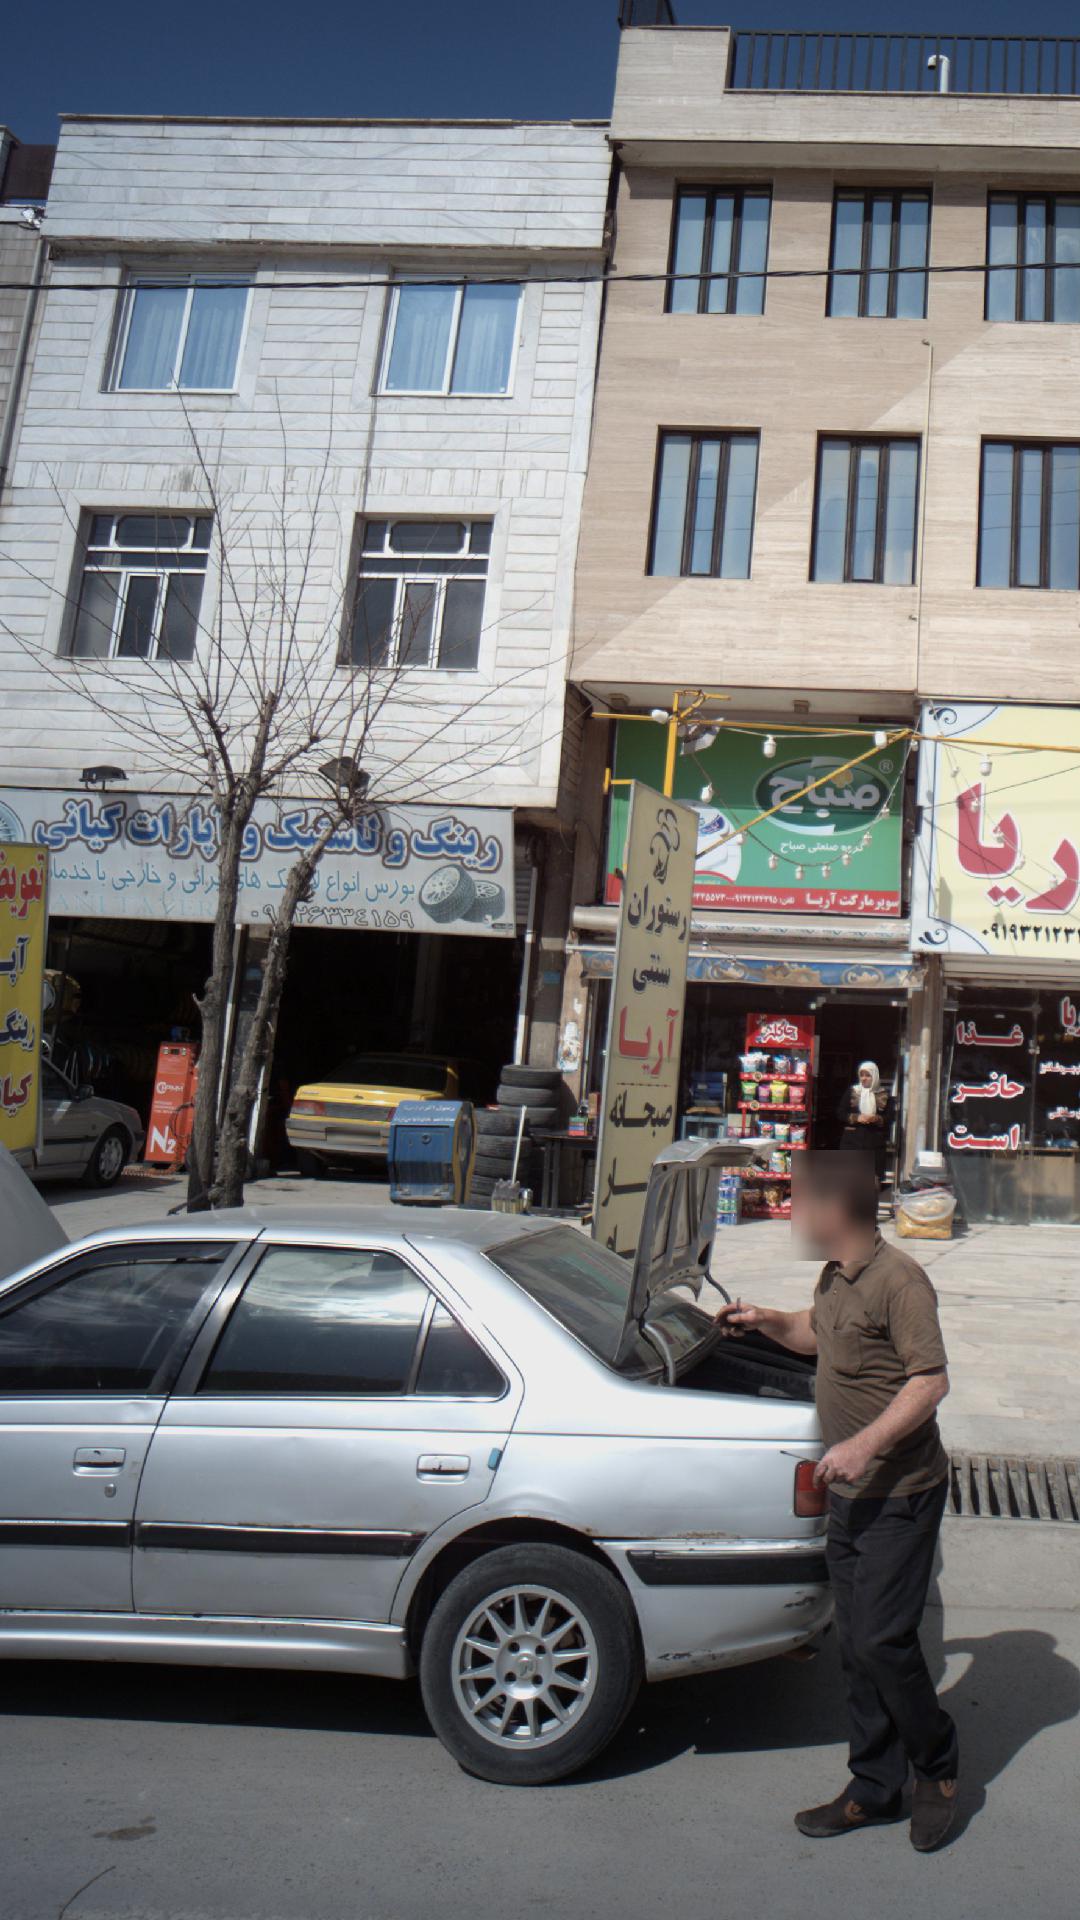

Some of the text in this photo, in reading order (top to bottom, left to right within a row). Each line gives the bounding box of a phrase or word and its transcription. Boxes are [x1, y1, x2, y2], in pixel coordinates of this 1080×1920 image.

[33, 799, 126, 853] کیانی
[382, 829, 411, 868] و
[411, 816, 503, 873] رینگ
[780, 841, 806, 852] صباح
[95, 859, 107, 883] با
[111, 863, 162, 891] خارجی
[167, 872, 177, 891] و
[326, 870, 361, 901] انواع
[365, 877, 416, 902] بورس
[805, 892, 835, 909] آریا
[627, 883, 687, 941] رستوران
[632, 954, 671, 992] سنتی
[619, 1006, 680, 1076] آریا
[956, 1021, 1025, 1046] غذا
[952, 1071, 1025, 1103] حاضر
[609, 1089, 673, 1138] صبحانه
[949, 1124, 1020, 1150] است
